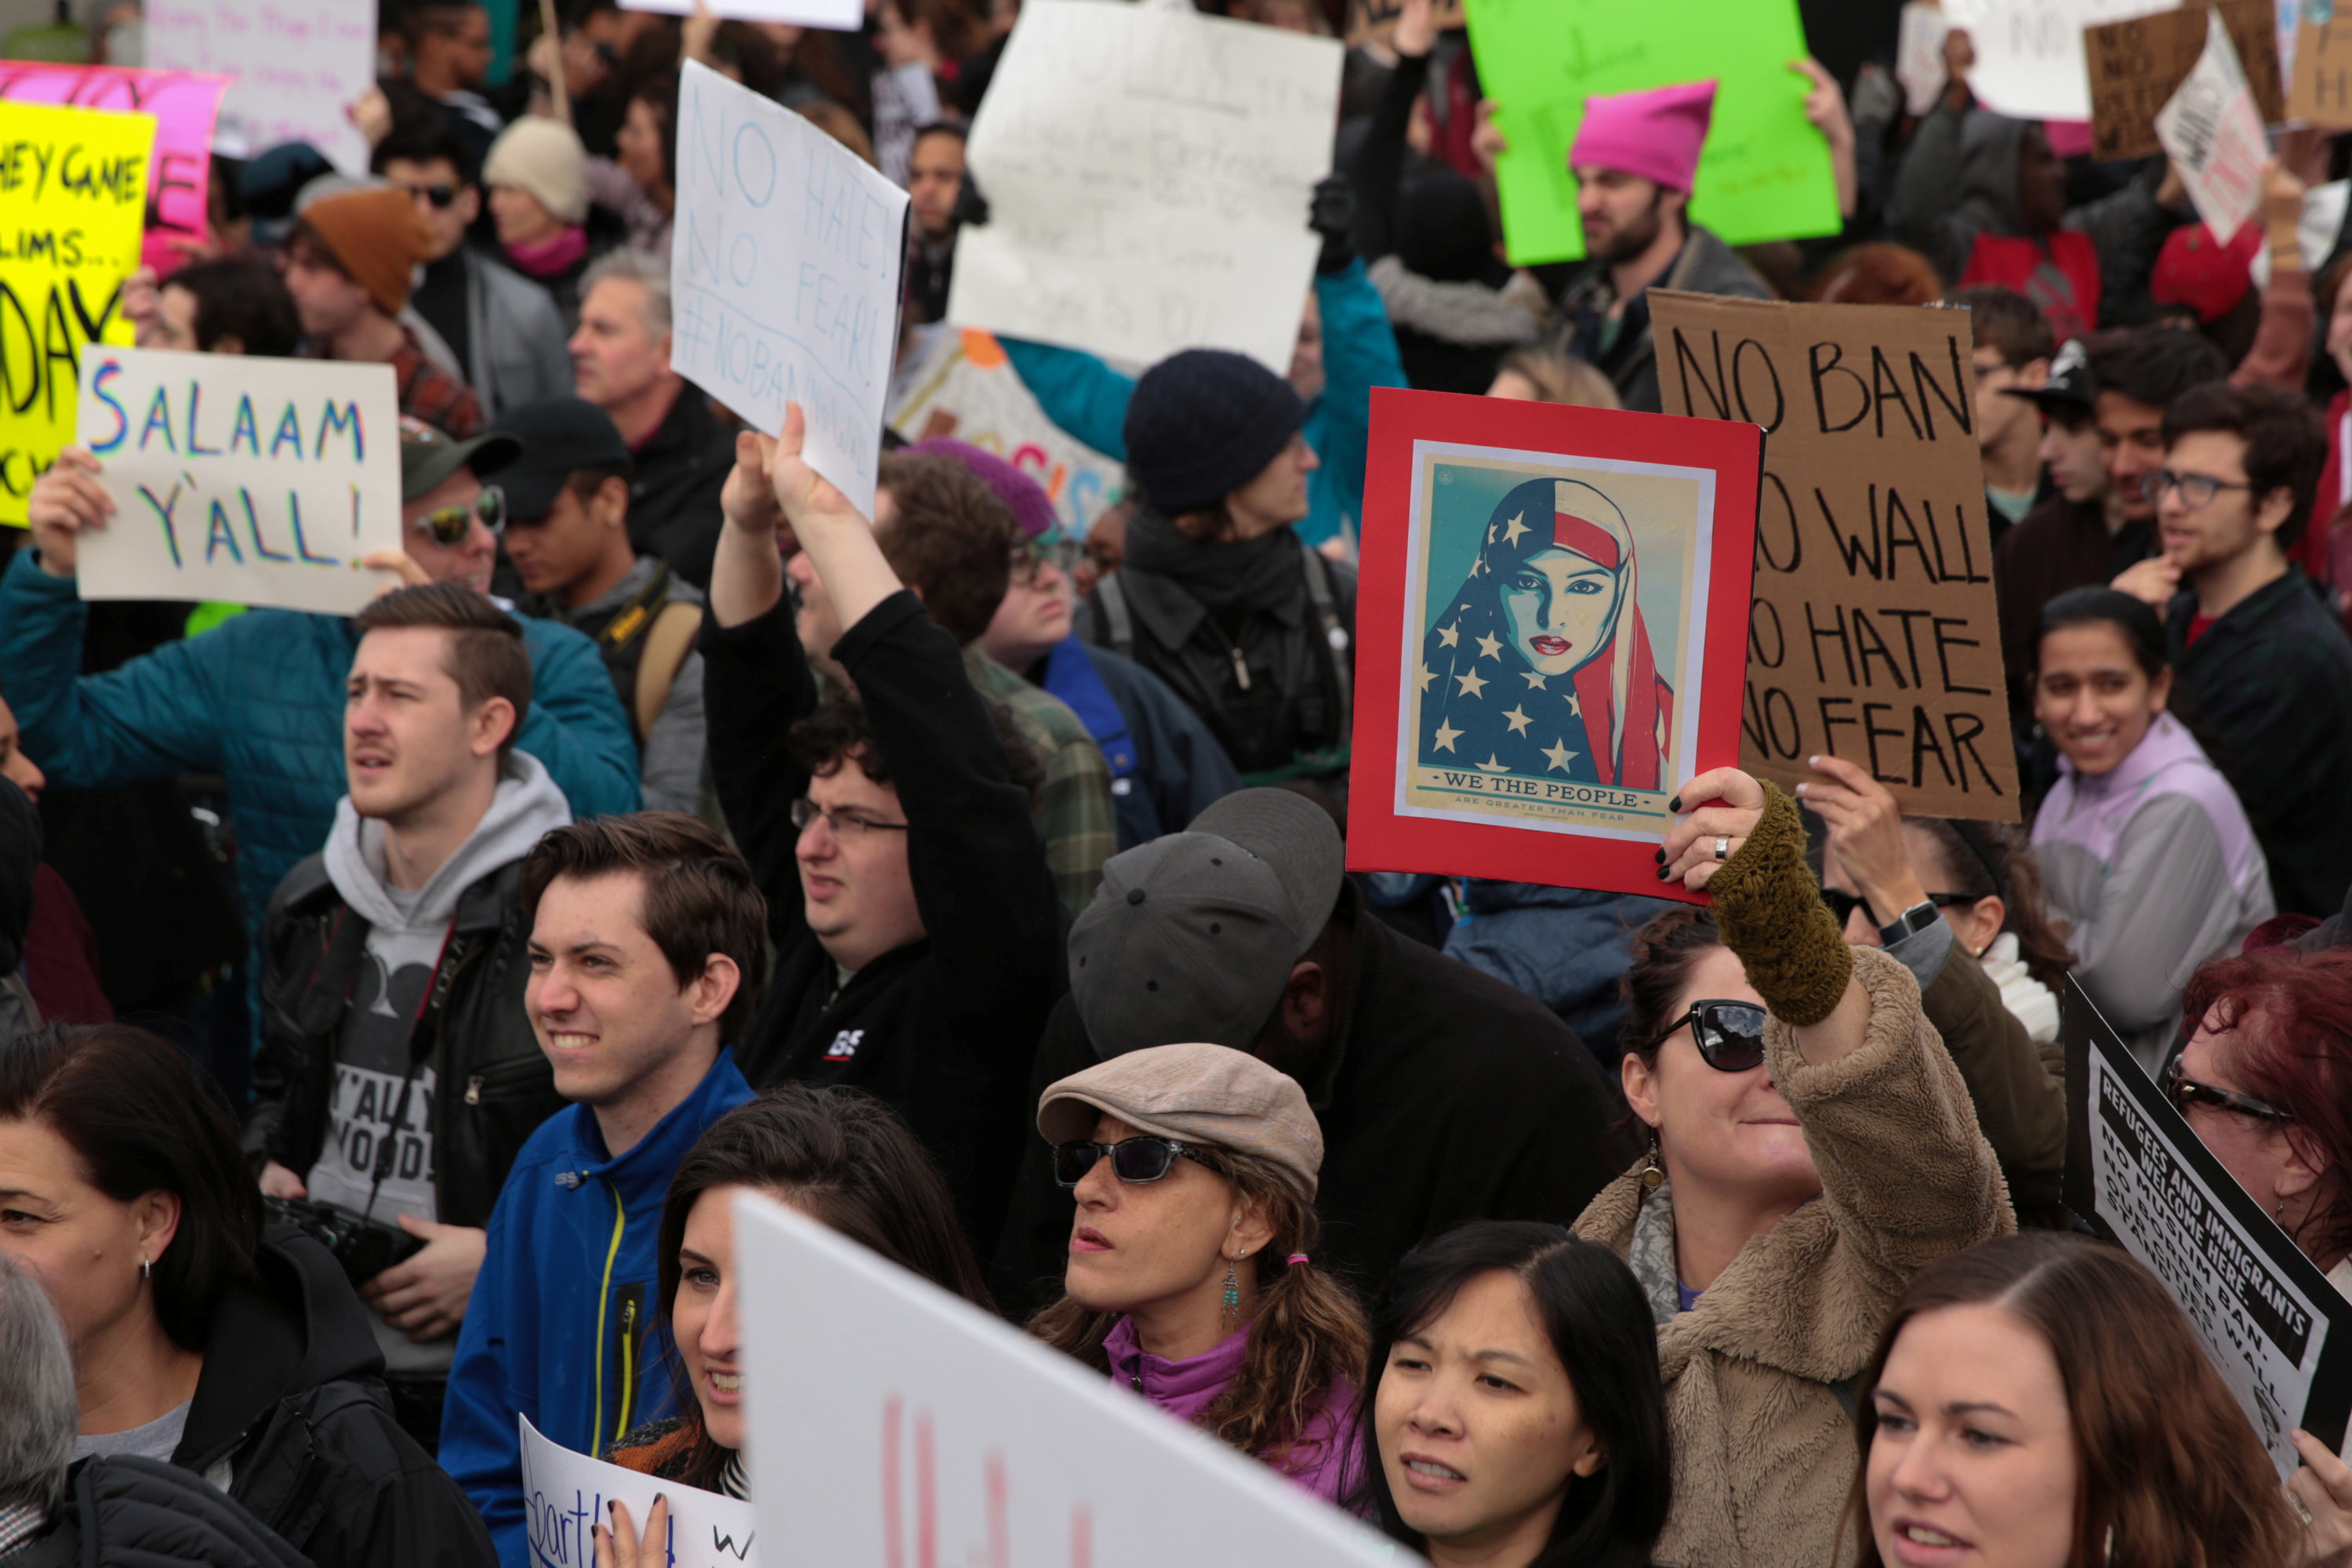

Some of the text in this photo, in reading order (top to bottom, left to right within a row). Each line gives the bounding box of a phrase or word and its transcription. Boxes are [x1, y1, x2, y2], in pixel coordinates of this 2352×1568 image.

[690, 84, 777, 209] NO
[688, 207, 879, 387] NO FEAR!
[89, 357, 365, 464] SALAAM
[1673, 327, 1972, 441] NO BAN
[1756, 472, 1991, 584] O WALL
[1748, 597, 1992, 696] O HATE
[1443, 771, 1638, 808] WE THE PEOPLE
[1817, 696, 2004, 797] FEAR
[1486, 800, 1544, 812] GREATER
[1551, 808, 1585, 817] THAN
[1592, 812, 1624, 821] FEAR
[2103, 1075, 2168, 1174] REFUGEES
[2171, 1169, 2201, 1215] AND
[2205, 1210, 2306, 1336] IMMIGRANTS
[2103, 1123, 2129, 1170] NO
[2136, 1172, 2211, 1285] MUSLIM
[2218, 1285, 2268, 1362] BAN.
[2107, 1175, 2147, 1240] OUR
[2154, 1240, 2213, 1330] CITIES
[2140, 1148, 2205, 1248] WELCOME
[2208, 1239, 2249, 1307] HERE.
[2103, 1149, 2131, 1193] NO
[2138, 1196, 2217, 1318] BORDER
[2223, 1317, 2287, 1417] WALL.
[2107, 1190, 2170, 1282] STAND
[2176, 1285, 2230, 1369] TALL.
